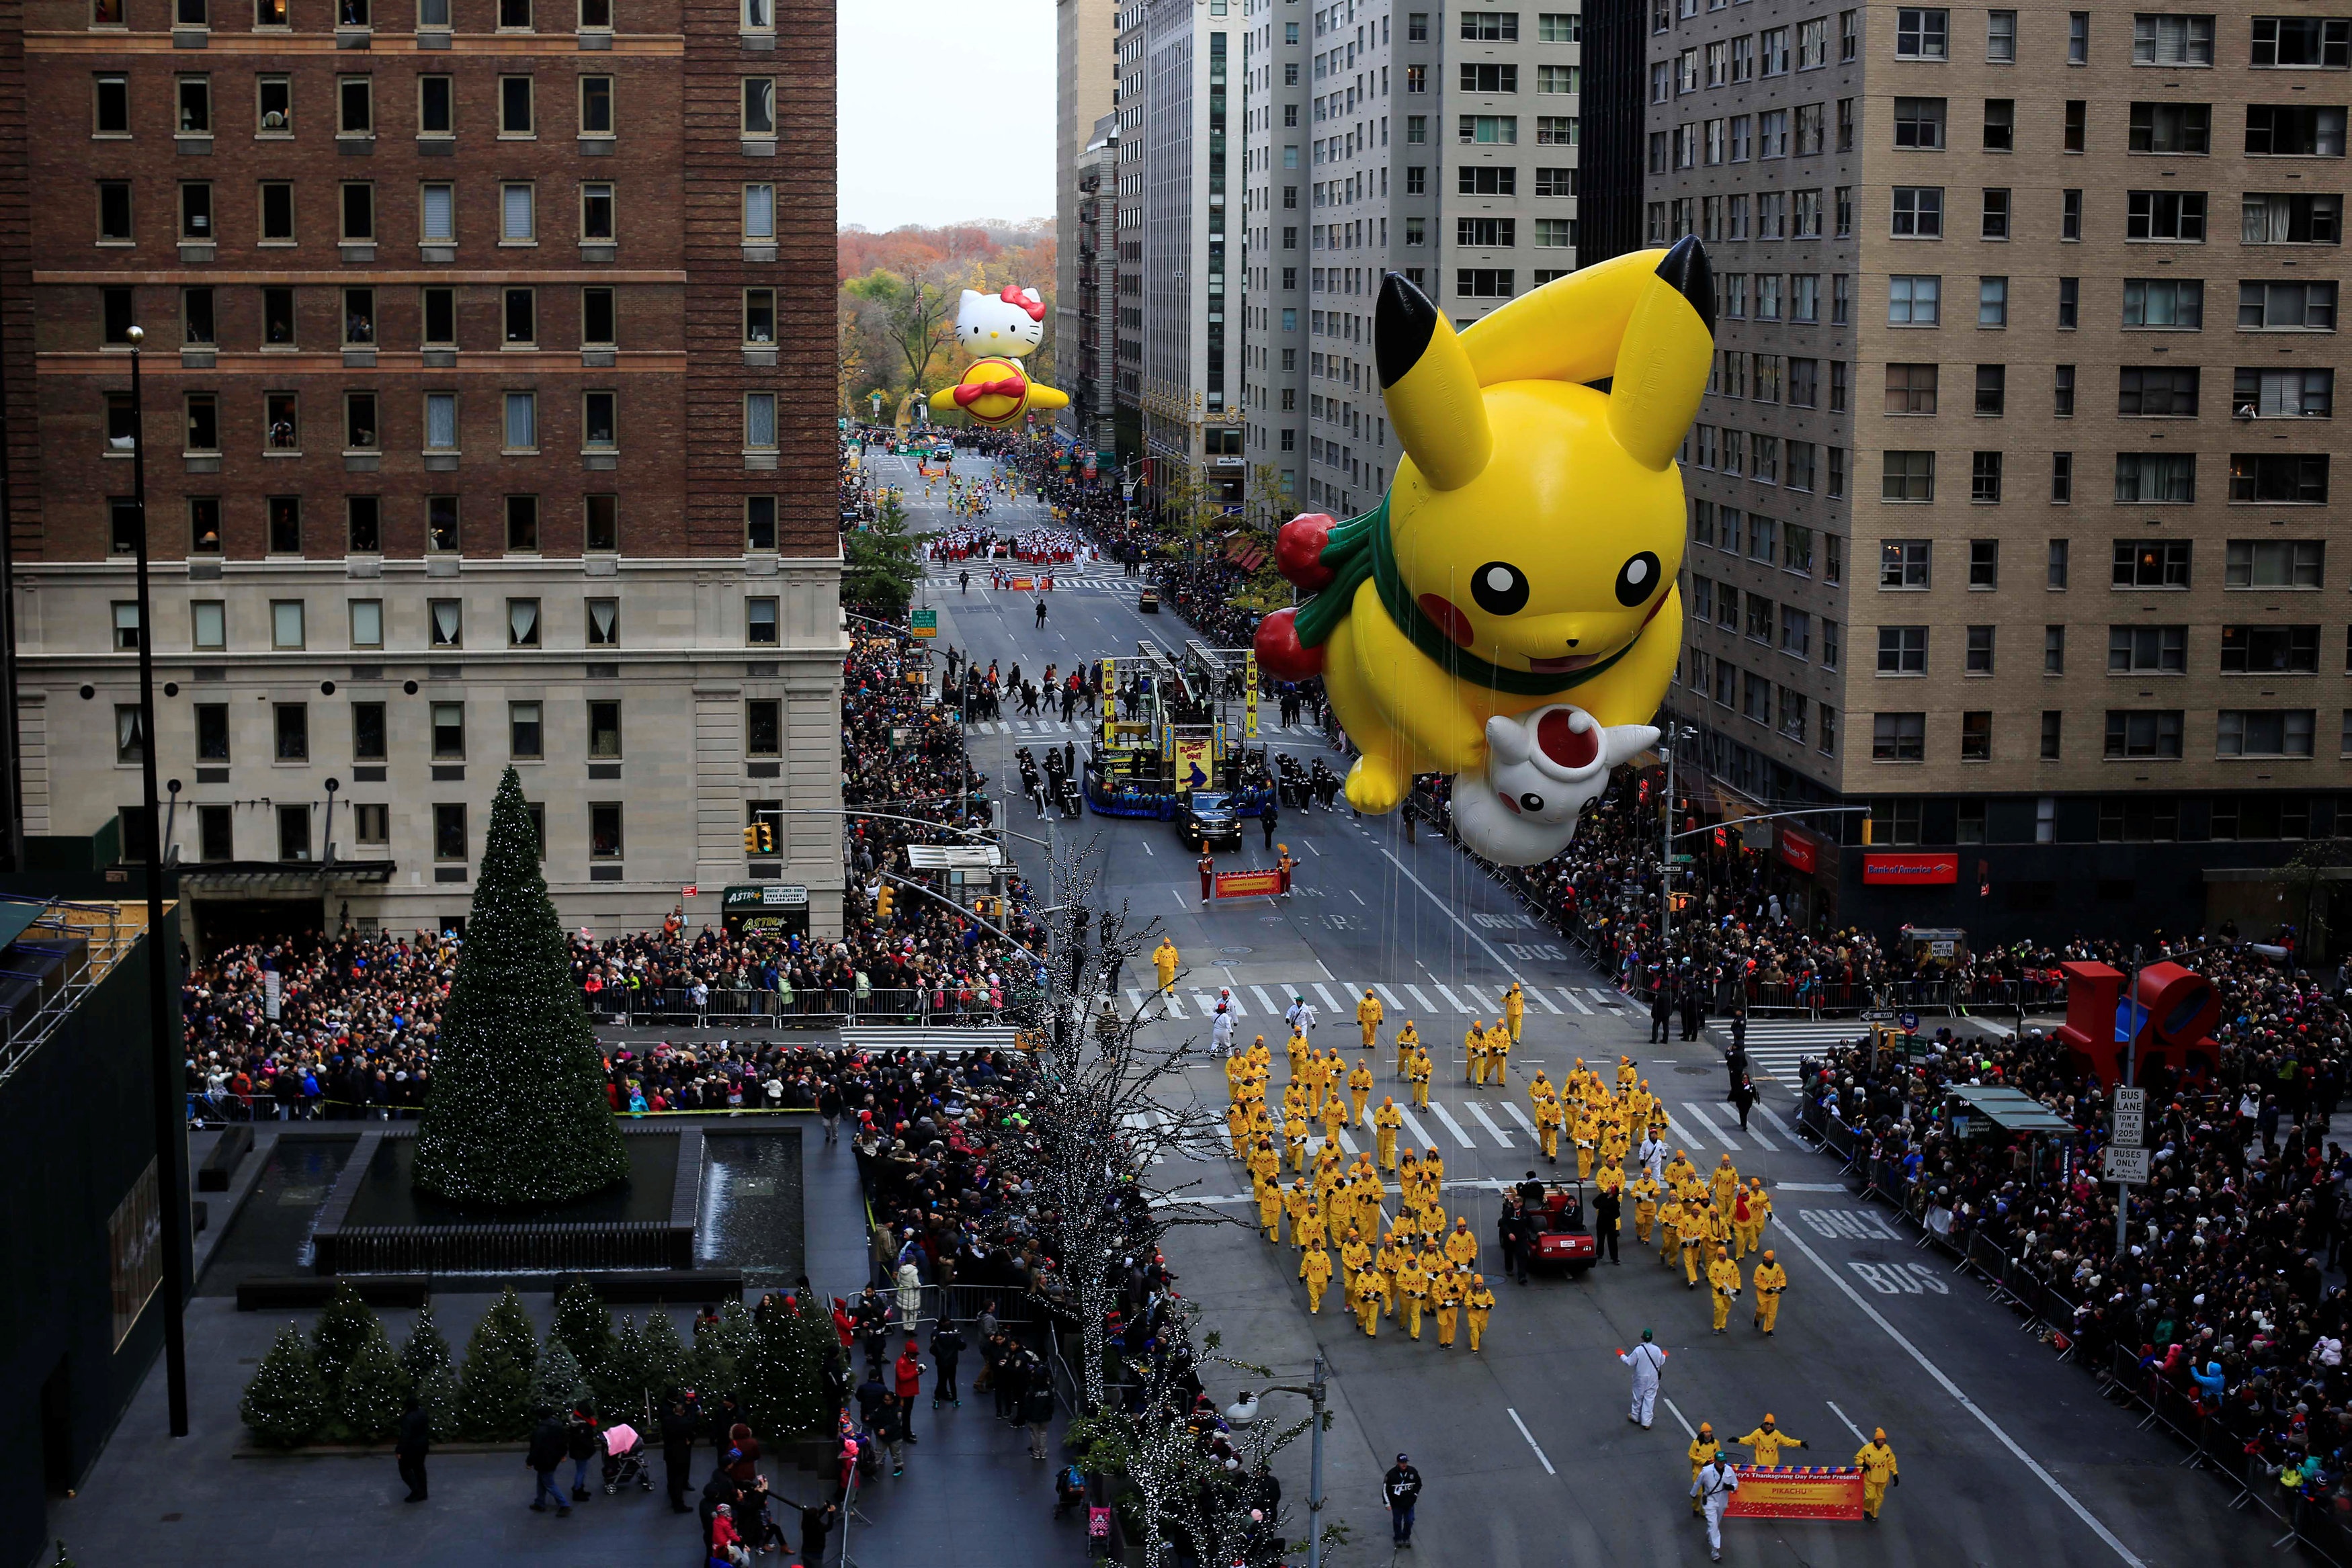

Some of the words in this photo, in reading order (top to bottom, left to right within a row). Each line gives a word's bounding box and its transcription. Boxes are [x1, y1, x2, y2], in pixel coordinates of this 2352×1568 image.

[1179, 742, 1206, 754] ROCK
[1867, 865, 1888, 873] Bank
[1888, 865, 1898, 873] of
[1898, 865, 1931, 874] America
[728, 891, 754, 903] ASTRO
[743, 917, 778, 932] ASTRO
[1472, 914, 1538, 929] ONLY
[1504, 943, 1568, 961] BUS
[2121, 1091, 2139, 1099] BUS
[2117, 1102, 2142, 1110] LANE
[2114, 1150, 2141, 1158] BUSES
[1799, 1209, 1903, 1240] ONLY
[1847, 1262, 1949, 1295] BUS
[1751, 1472, 1793, 1480] Thanksgiving
